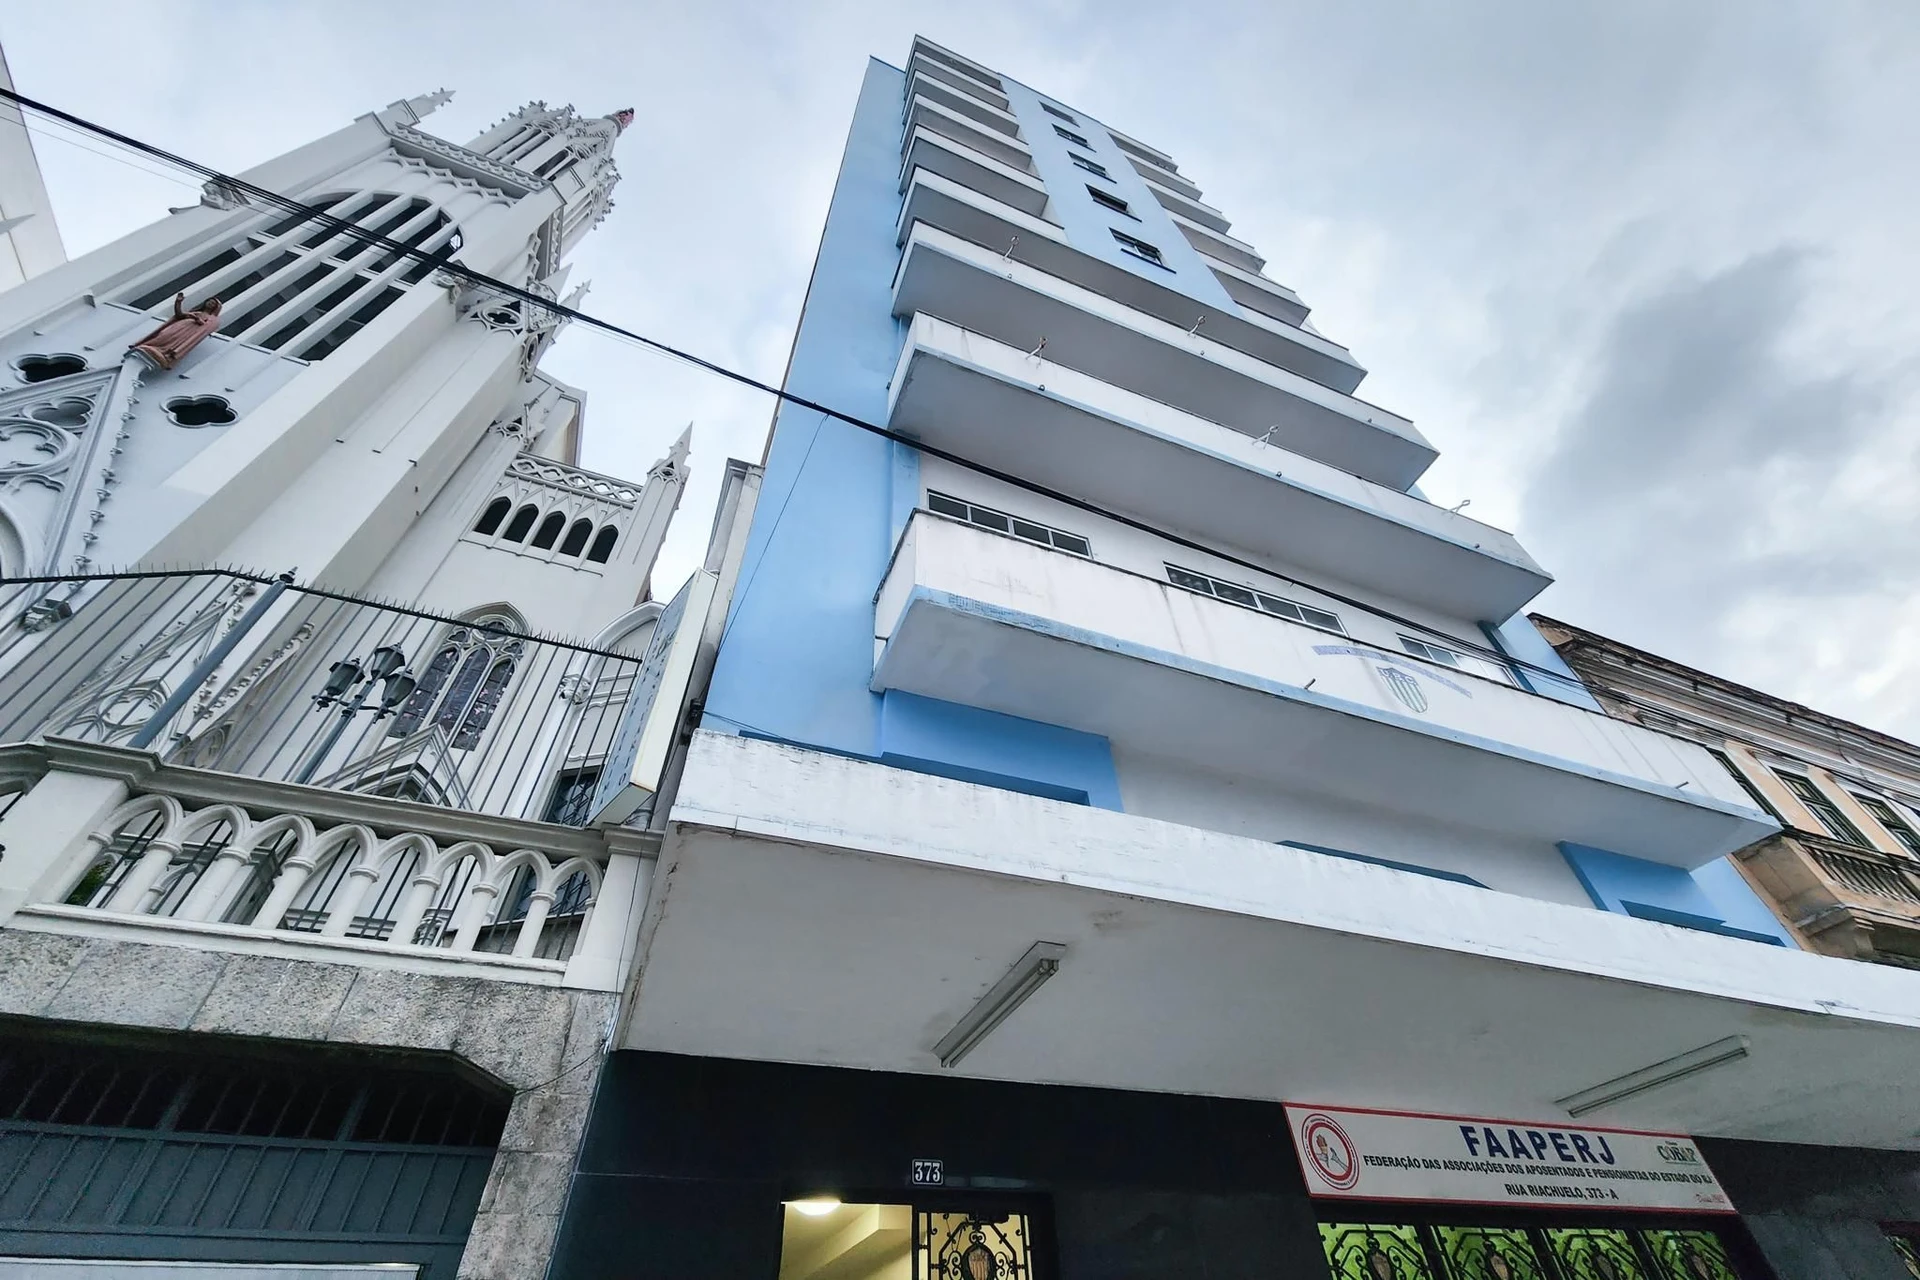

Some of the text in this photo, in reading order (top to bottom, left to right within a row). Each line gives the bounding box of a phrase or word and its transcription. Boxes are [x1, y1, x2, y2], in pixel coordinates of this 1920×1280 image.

[1459, 1125, 1615, 1165] FAAPERJ
[915, 1161, 941, 1182] 373
[1363, 1155, 1421, 1170] FEDERAÇÃO
[1422, 1158, 1441, 1170] DAS
[1443, 1160, 1505, 1174] ASSOCIAÇÕES
[1505, 1163, 1525, 1175] DOS
[1525, 1165, 1586, 1177] APOSENTADOS
[1587, 1168, 1593, 1178] E
[1593, 1168, 1648, 1180] PENSIONISTAS
[1649, 1172, 1661, 1181] DO
[1661, 1172, 1690, 1183] ESTADO
[1504, 1184, 1527, 1196] RUA
[1527, 1184, 1588, 1200] RIACHUELO,
[1587, 1188, 1603, 1199] 373
[1609, 1189, 1619, 1200] A
